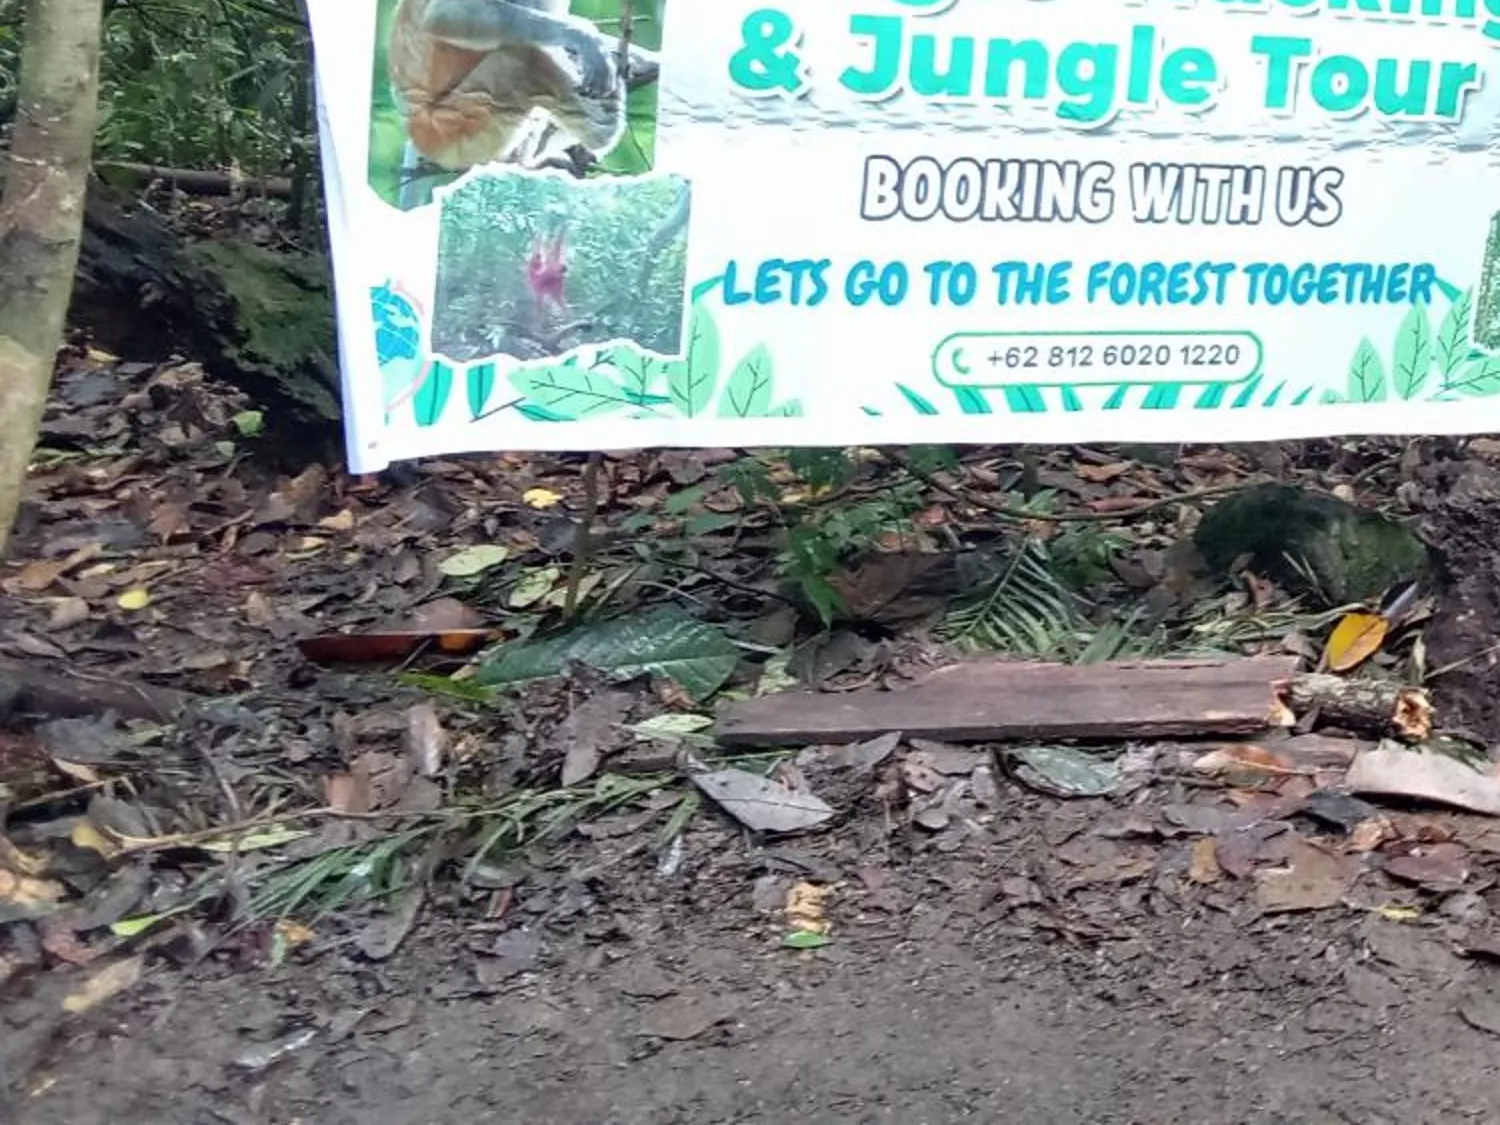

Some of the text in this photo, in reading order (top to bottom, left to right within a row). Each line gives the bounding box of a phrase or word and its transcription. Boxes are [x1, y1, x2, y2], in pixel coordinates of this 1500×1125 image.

[728, 8, 1477, 122] & Jungle Tour
[860, 154, 1345, 228] BOOKING WITH US
[723, 258, 1435, 306] LETS GO TO THE FOREST TOGETHER
[987, 344, 1241, 369] +62 812 6020 1220
